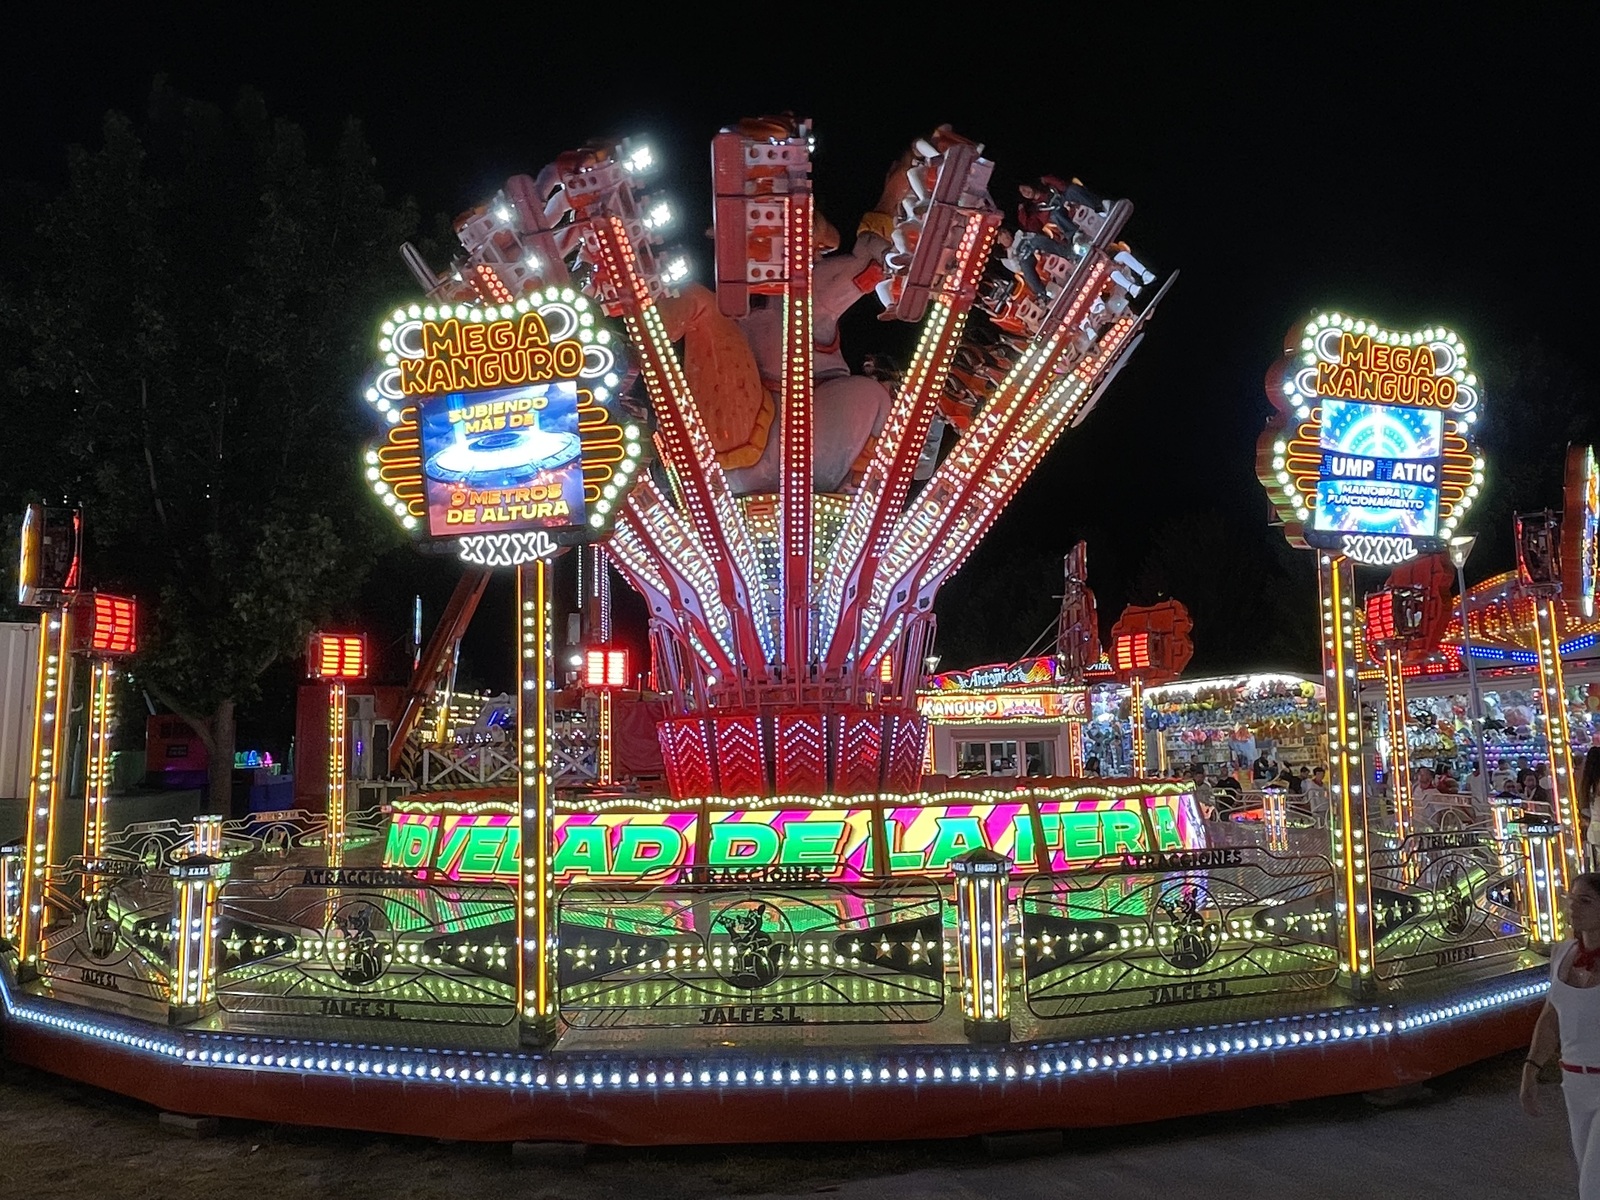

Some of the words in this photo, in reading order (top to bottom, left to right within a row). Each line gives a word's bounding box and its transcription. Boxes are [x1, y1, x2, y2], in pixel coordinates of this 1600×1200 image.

[422, 312, 550, 360] MEGA
[1340, 333, 1436, 378] MEGA
[400, 340, 585, 395] KANGURO
[1316, 362, 1458, 408] KANGURO
[448, 396, 549, 423] SUBIENDO
[464, 414, 506, 435] MÁS
[509, 413, 535, 428] DE
[955, 413, 1003, 468] XXXL
[984, 439, 1033, 488] XXXL
[450, 490, 466, 506] 9
[469, 483, 563, 506] METROS
[1327, 494, 1425, 510] FUNCIONAMIENTO
[1342, 484, 1402, 498] MANIOBRA
[1402, 488, 1414, 499] Y
[446, 508, 477, 525] DE
[480, 500, 571, 523] ALTURA
[718, 492, 739, 541] MEGA
[836, 490, 875, 573] KANGURO
[459, 531, 558, 566] XXXL
[878, 500, 941, 577] KANGURO
[1343, 536, 1418, 565] XXXL
[646, 502, 684, 552] MEGA
[677, 545, 728, 629] KANGURO
[921, 698, 998, 717] KANGURO
[709, 821, 847, 873] DE
[863, 816, 992, 871] LA
[1148, 984, 1201, 1004] JALFE
[699, 1006, 765, 1023] JALFE
[771, 1006, 805, 1023] S.L.
